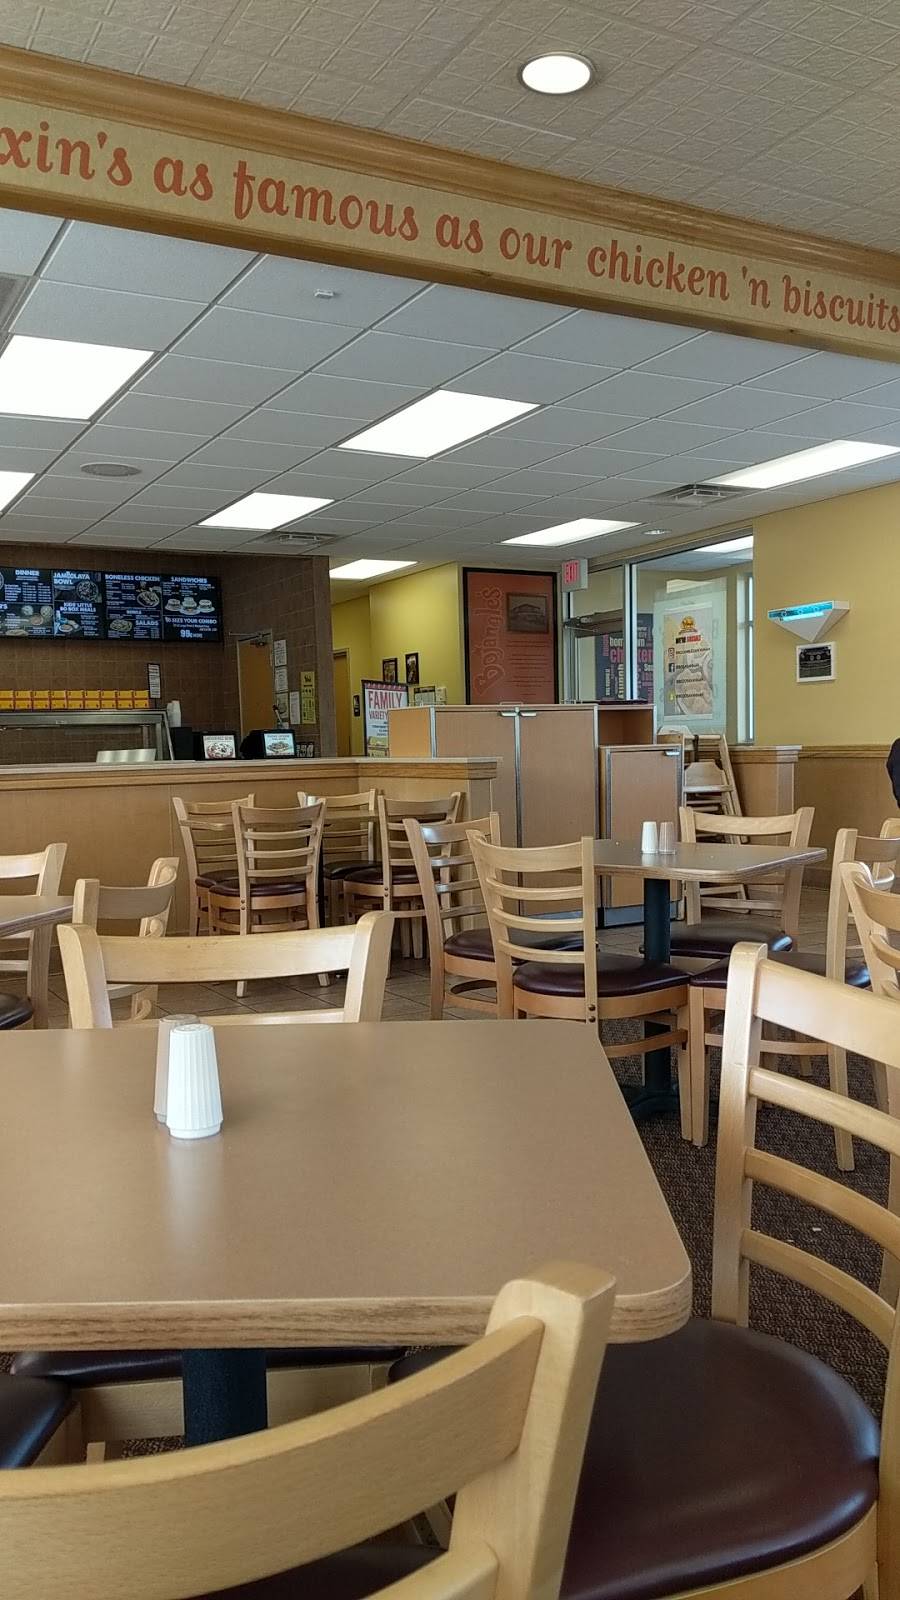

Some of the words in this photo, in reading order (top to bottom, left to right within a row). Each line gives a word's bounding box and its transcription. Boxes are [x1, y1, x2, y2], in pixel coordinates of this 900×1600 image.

[153, 156, 213, 201] as
[233, 160, 419, 241] famous
[435, 213, 484, 254] as
[499, 226, 572, 270] our
[586, 239, 729, 301] chicken
[741, 266, 770, 309] 'n
[782, 274, 900, 333] biscuits
[53, 571, 91, 580] JAMBALAYA
[170, 576, 208, 584] SANDWICHES
[564, 559, 579, 584] EXIT
[368, 690, 403, 709] FAMILY
